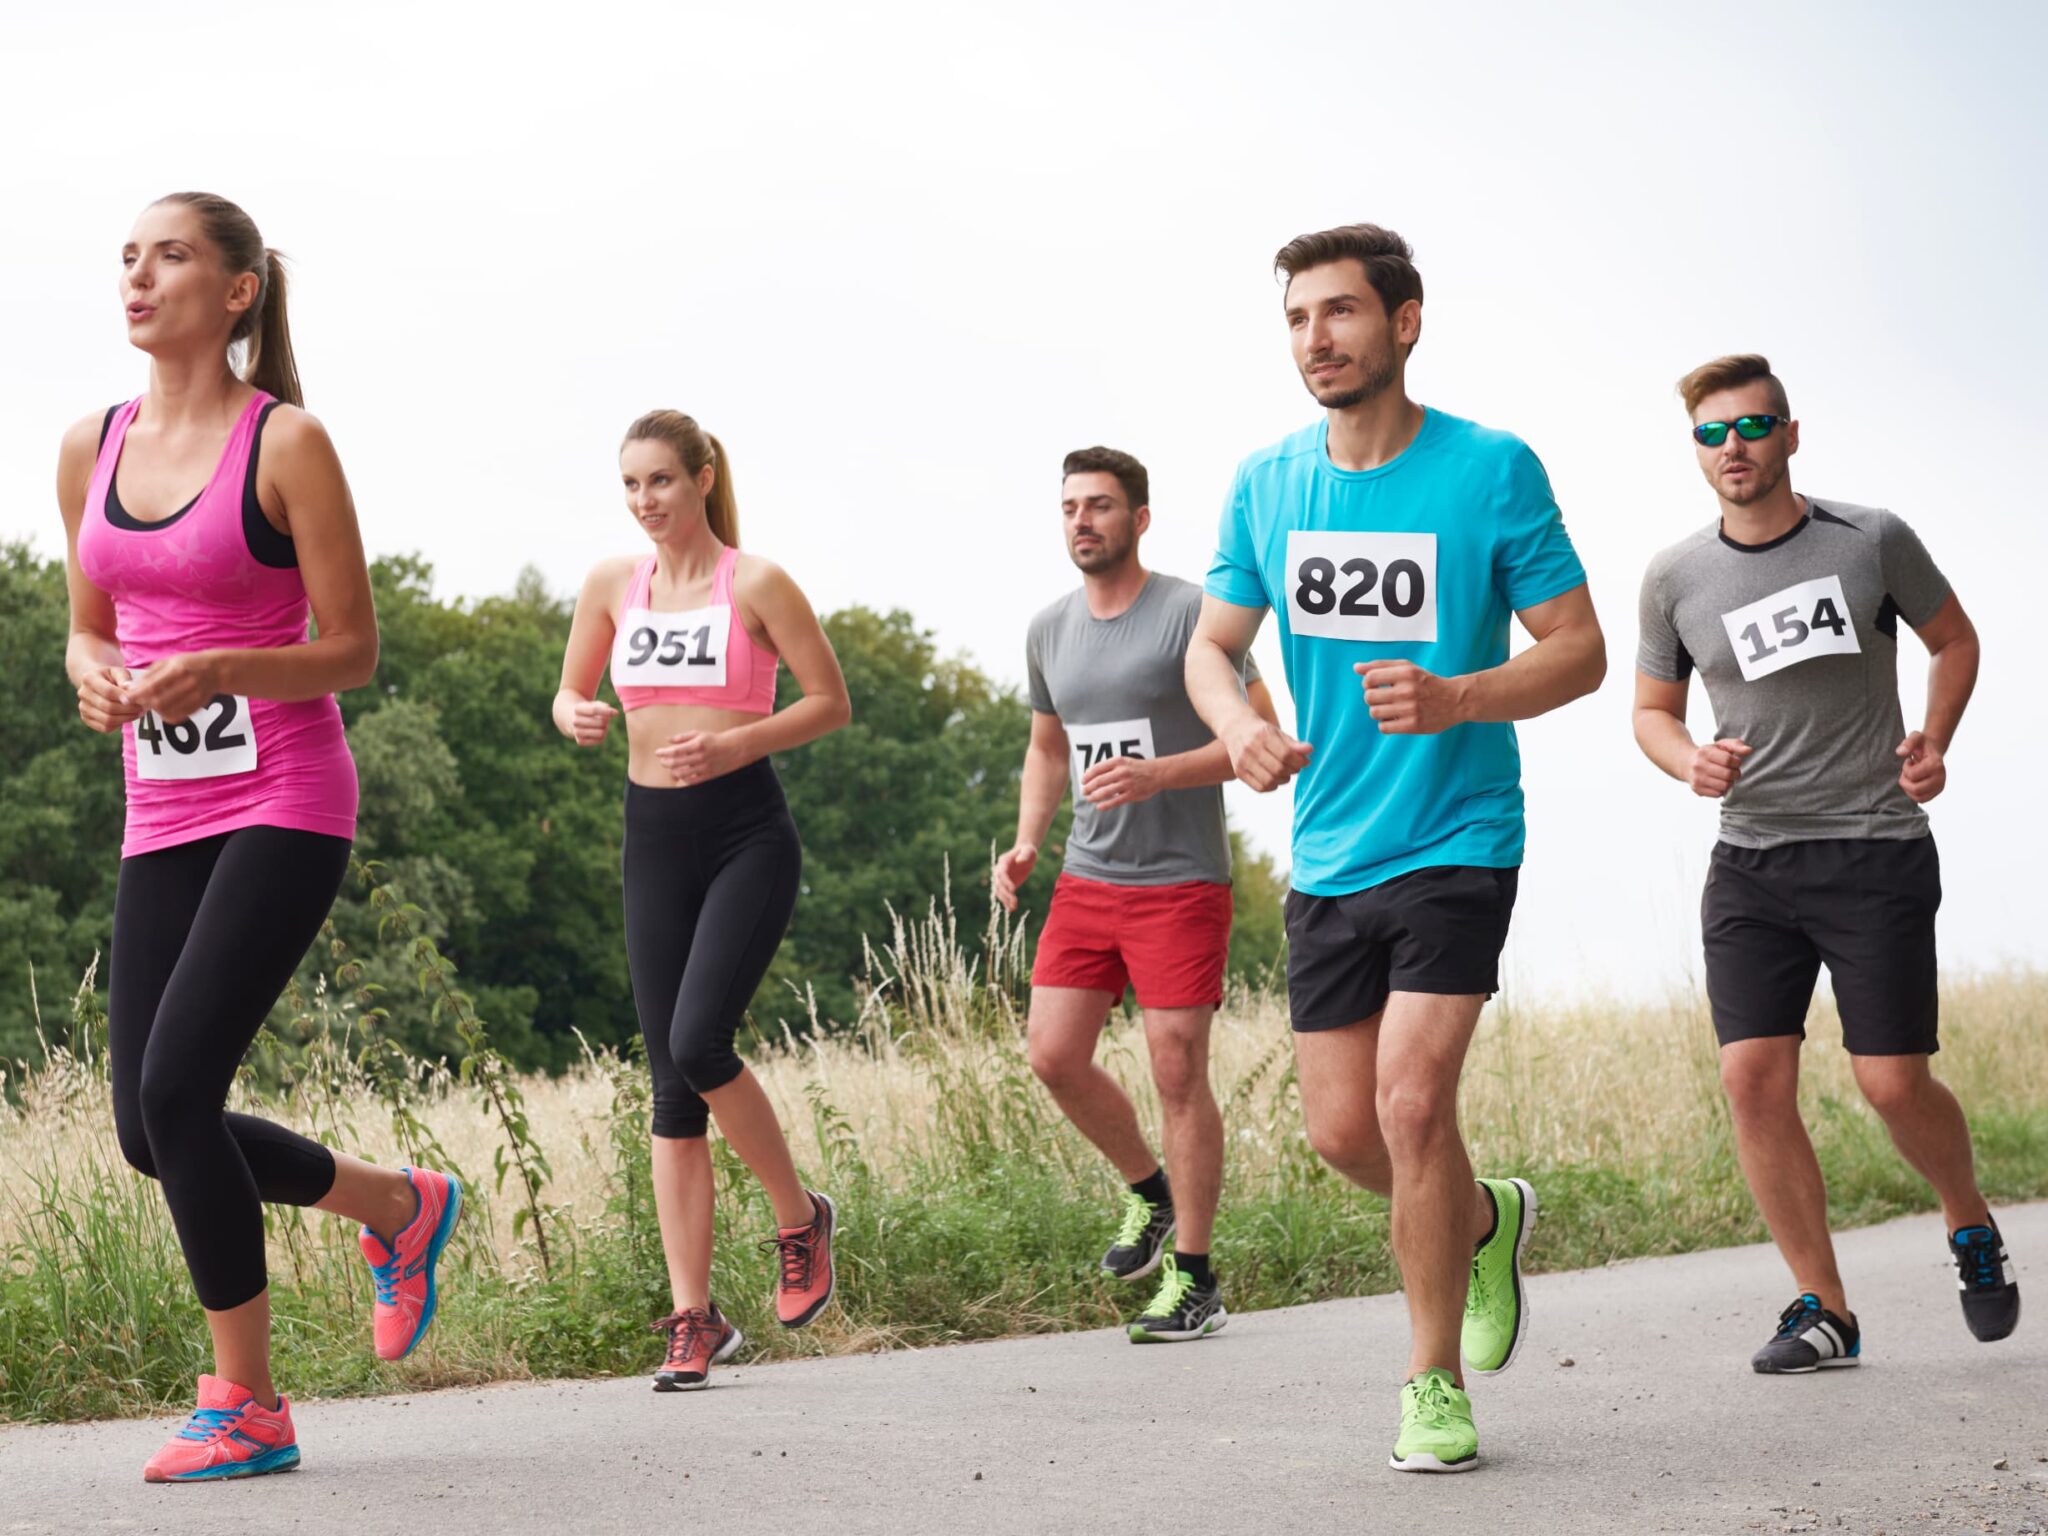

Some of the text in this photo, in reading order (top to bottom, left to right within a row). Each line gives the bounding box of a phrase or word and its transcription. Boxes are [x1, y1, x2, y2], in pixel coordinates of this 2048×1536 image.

[1295, 556, 1425, 618] 820
[627, 624, 716, 666] 951
[1740, 597, 1847, 664] 154
[138, 692, 247, 755] 462
